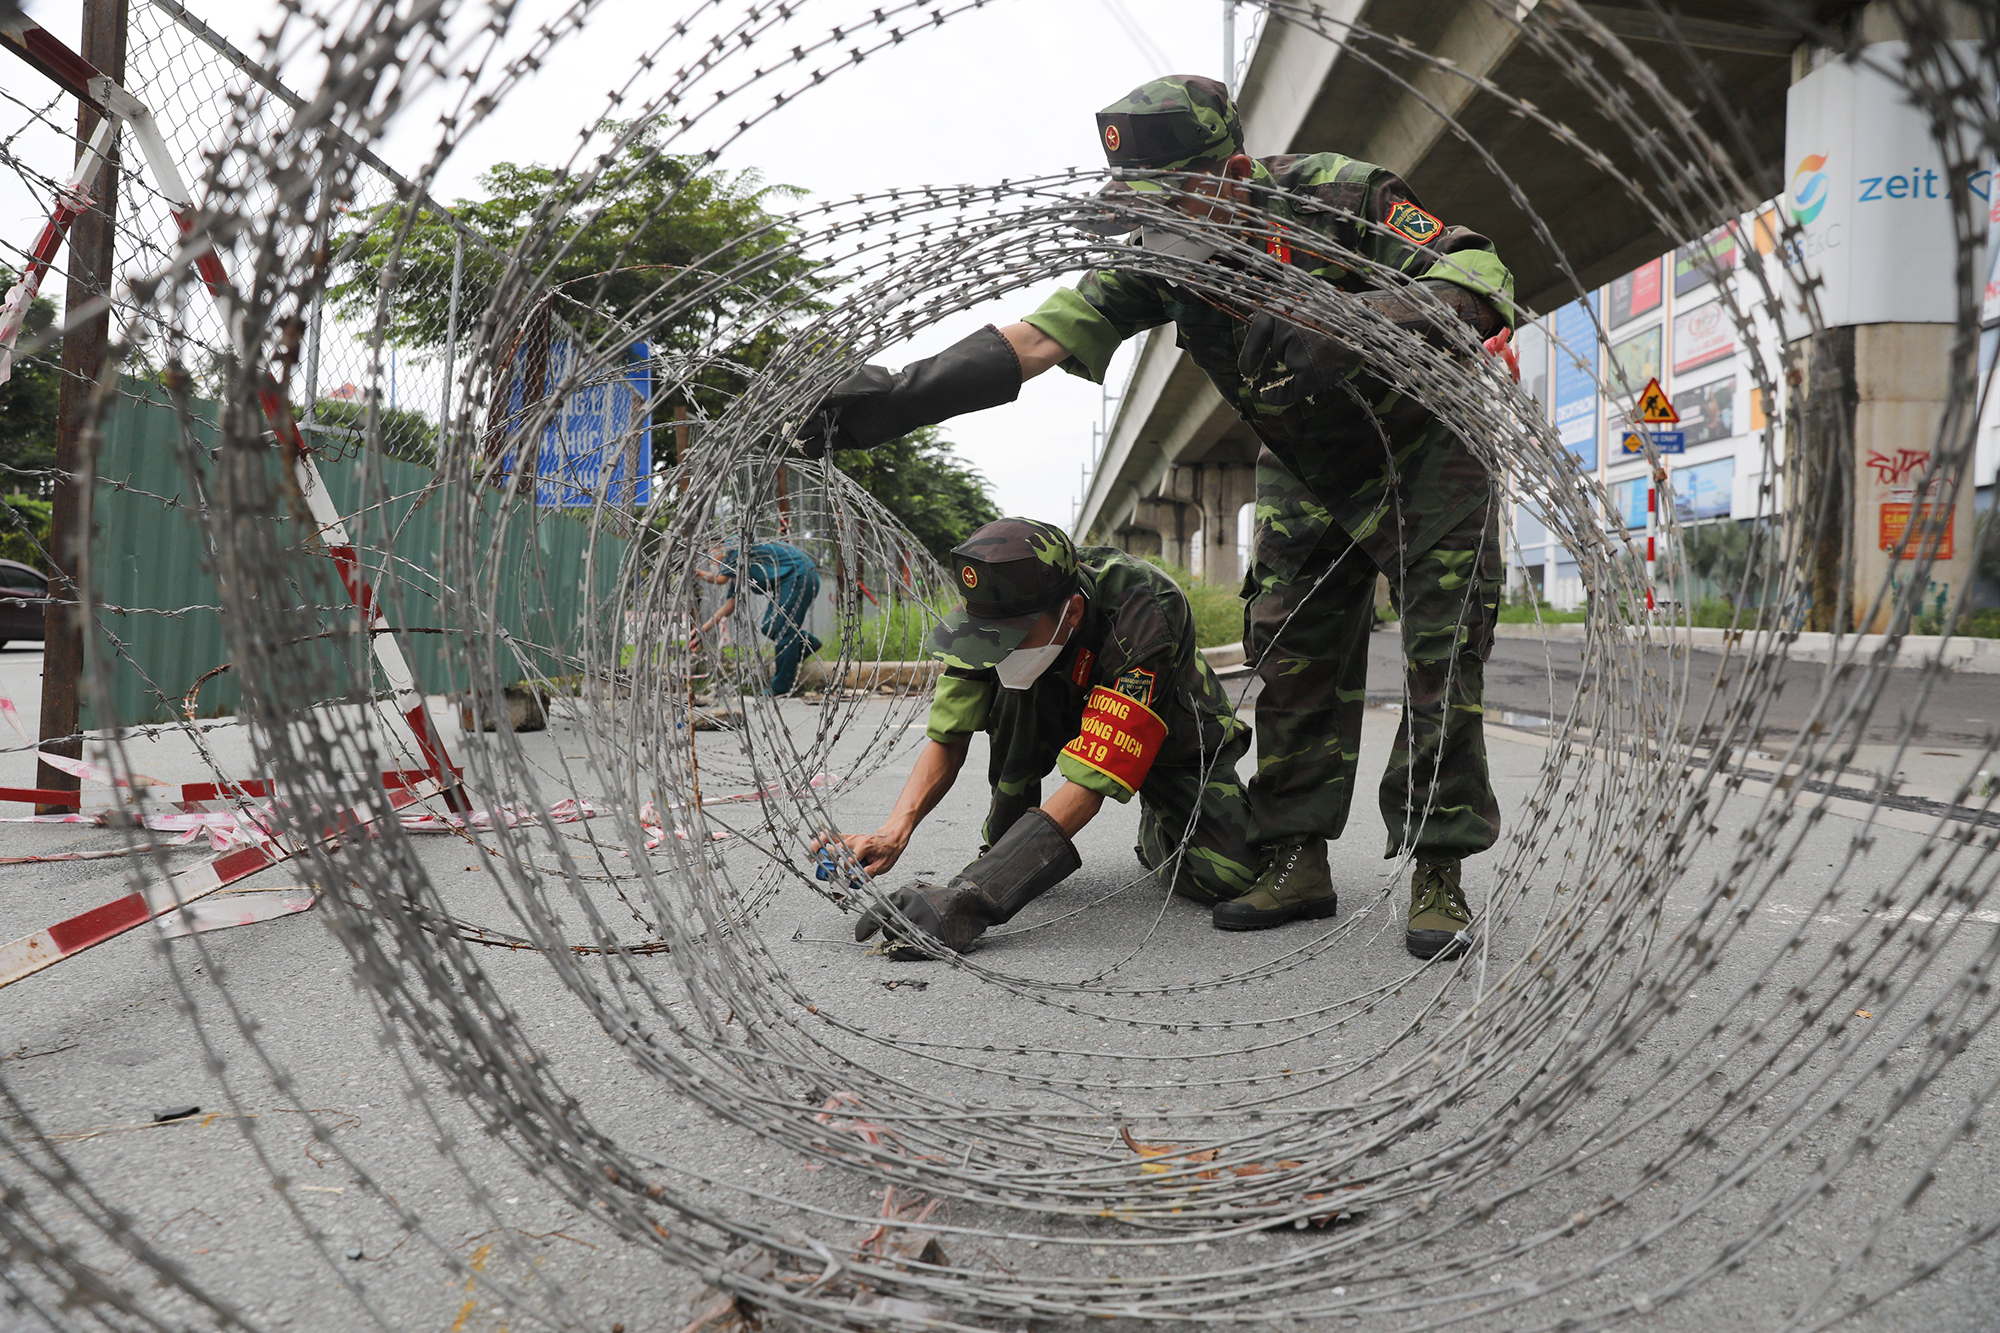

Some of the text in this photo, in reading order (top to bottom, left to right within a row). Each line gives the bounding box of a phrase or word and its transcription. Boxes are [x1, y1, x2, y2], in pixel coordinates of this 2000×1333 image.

[1857, 167, 1938, 202] zeit
[1087, 693, 1131, 721] LƯỢNG
[1113, 730, 1143, 758] DỊCH
